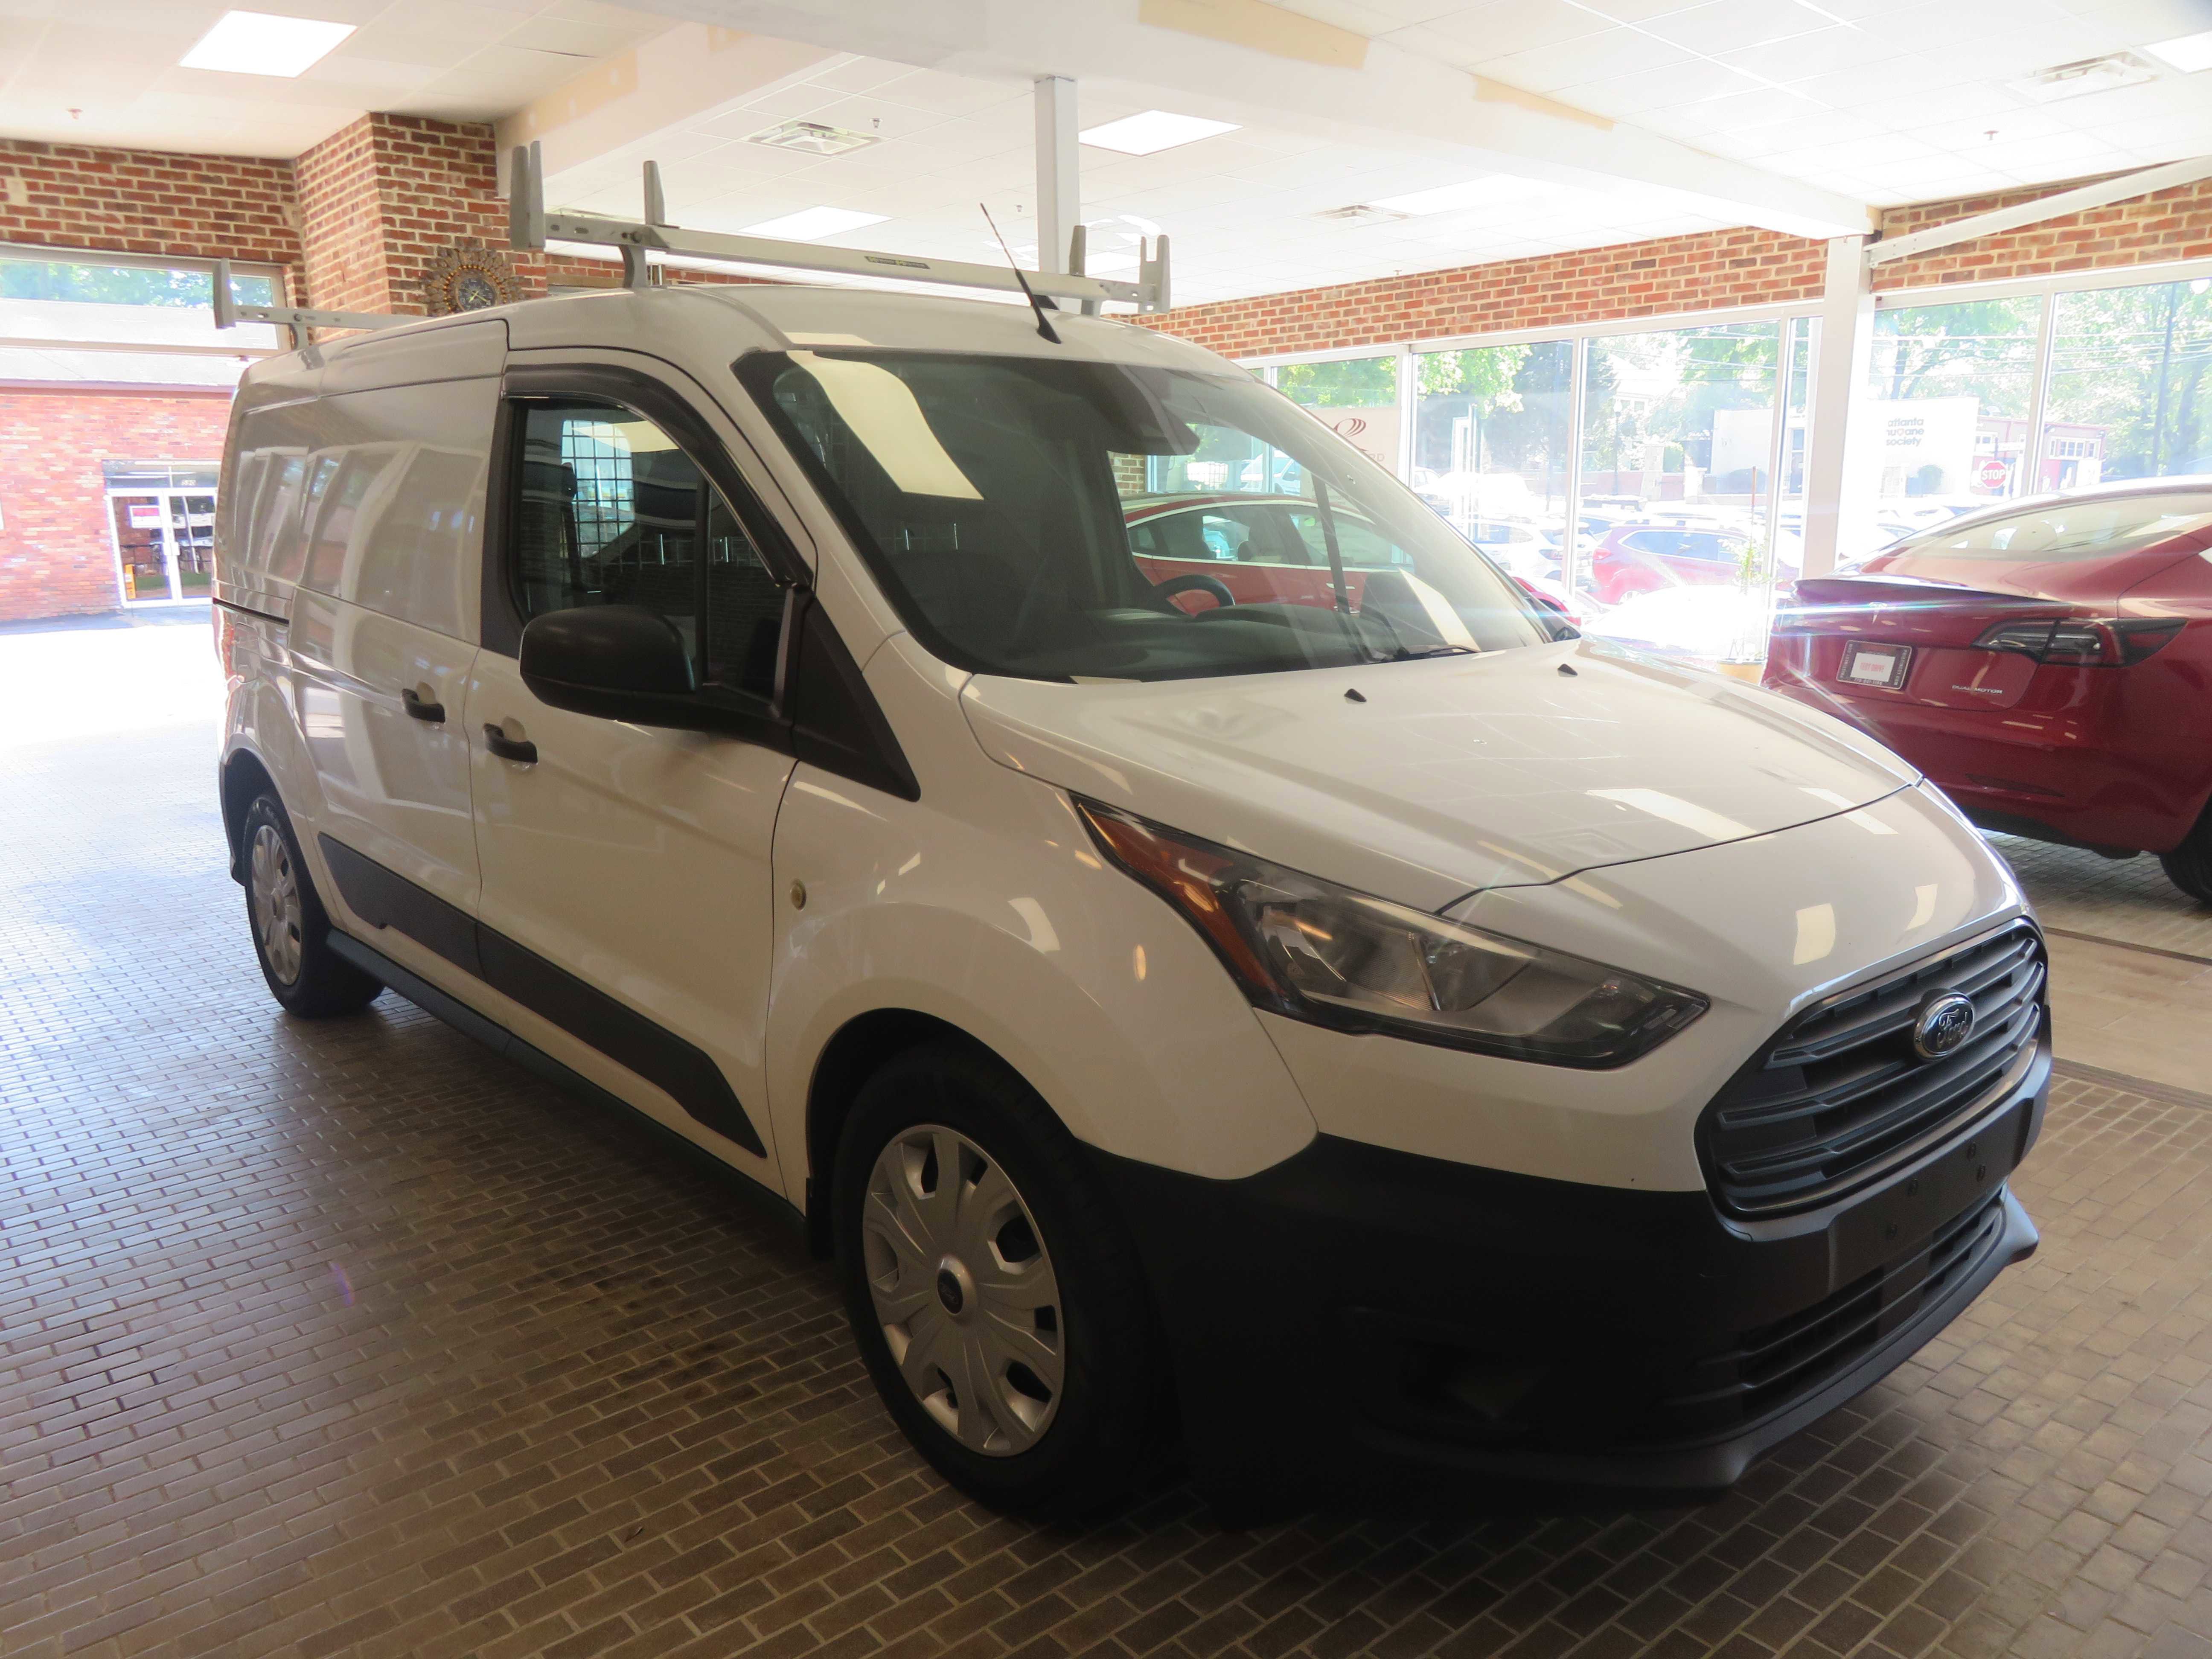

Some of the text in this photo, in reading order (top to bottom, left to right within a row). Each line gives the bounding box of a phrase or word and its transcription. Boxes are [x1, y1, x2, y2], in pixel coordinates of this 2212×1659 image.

[1887, 417, 1924, 427] atlanta
[1886, 437, 1922, 447] society
[1982, 469, 2005, 480] STOP
[1936, 1008, 1968, 1049] Ford
